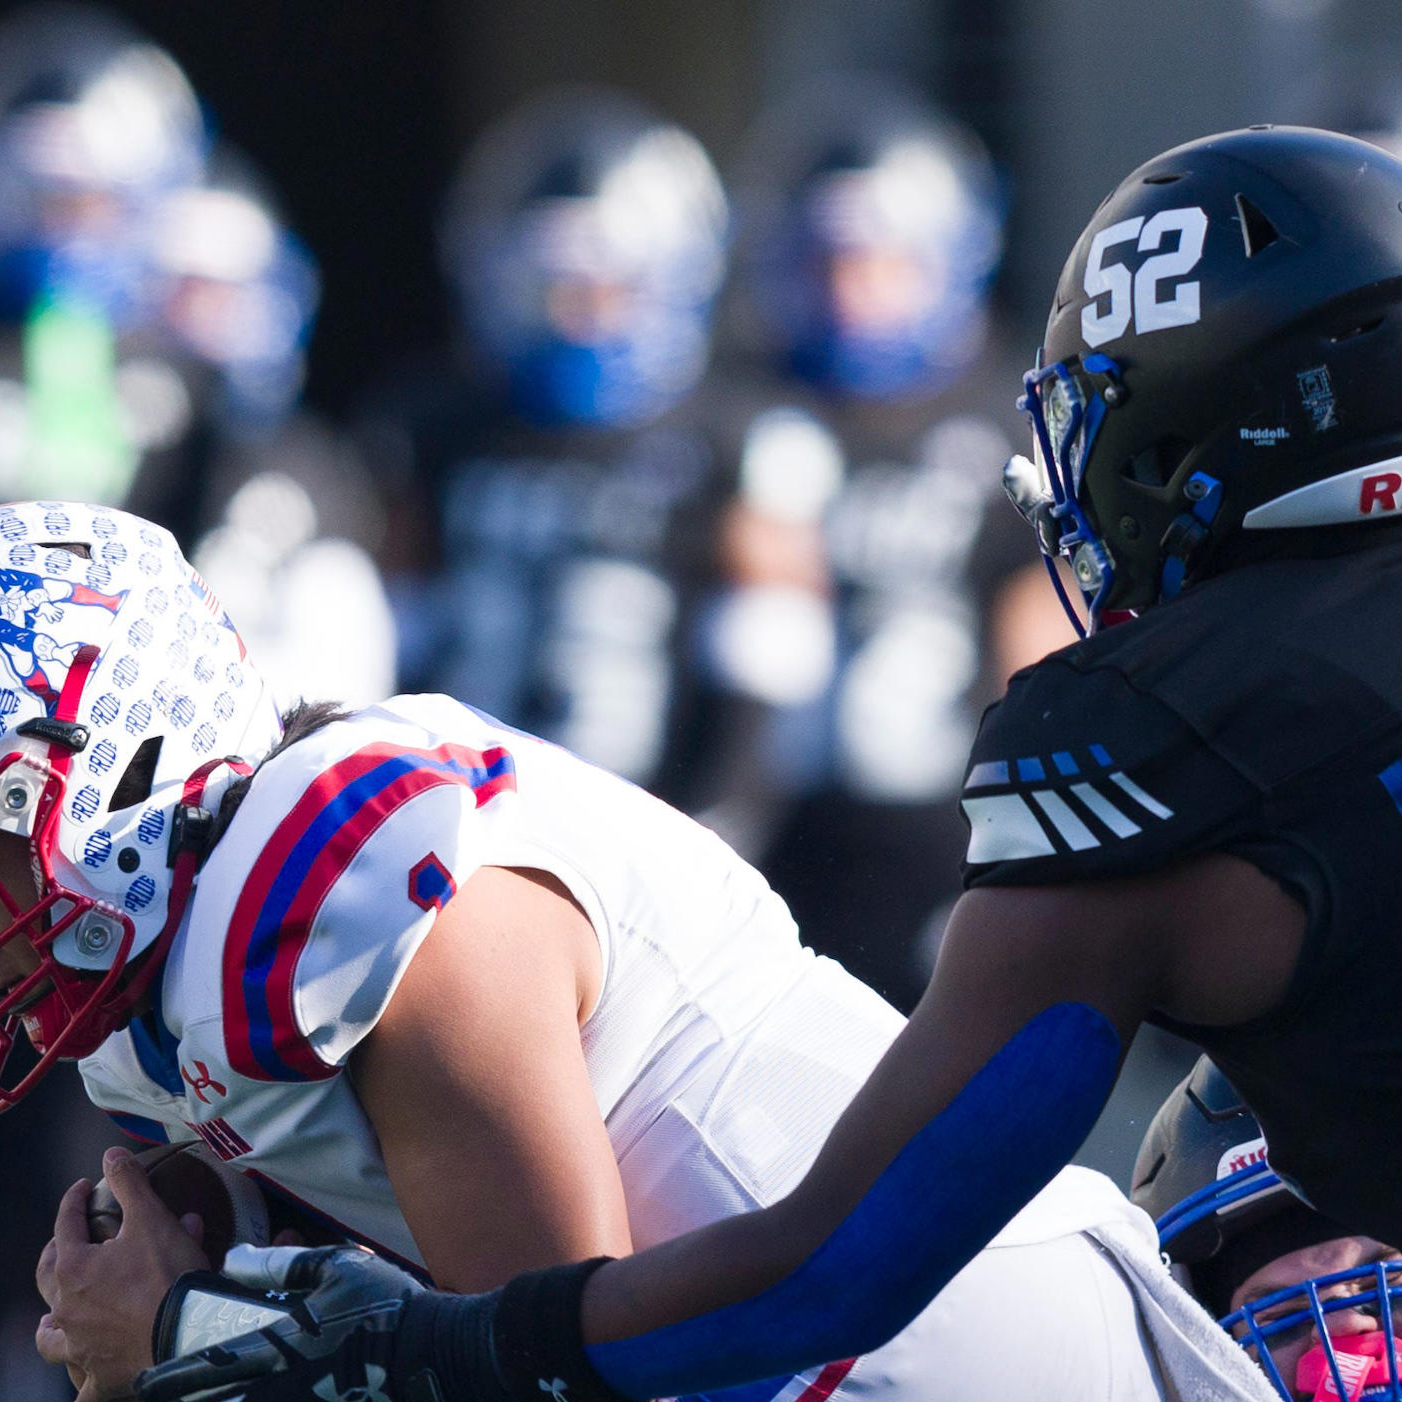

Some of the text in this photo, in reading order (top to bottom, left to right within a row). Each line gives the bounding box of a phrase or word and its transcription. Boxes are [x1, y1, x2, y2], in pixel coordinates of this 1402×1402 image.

[1081, 206, 1209, 349] 52
[90, 692, 121, 727] PRIDE
[125, 699, 152, 736] PRIDE
[89, 738, 118, 776] PRIDE
[71, 784, 102, 823] PRIDE
[138, 806, 165, 845] PRIDE
[84, 828, 112, 869] PRIDE
[125, 874, 156, 912] PRIDE
